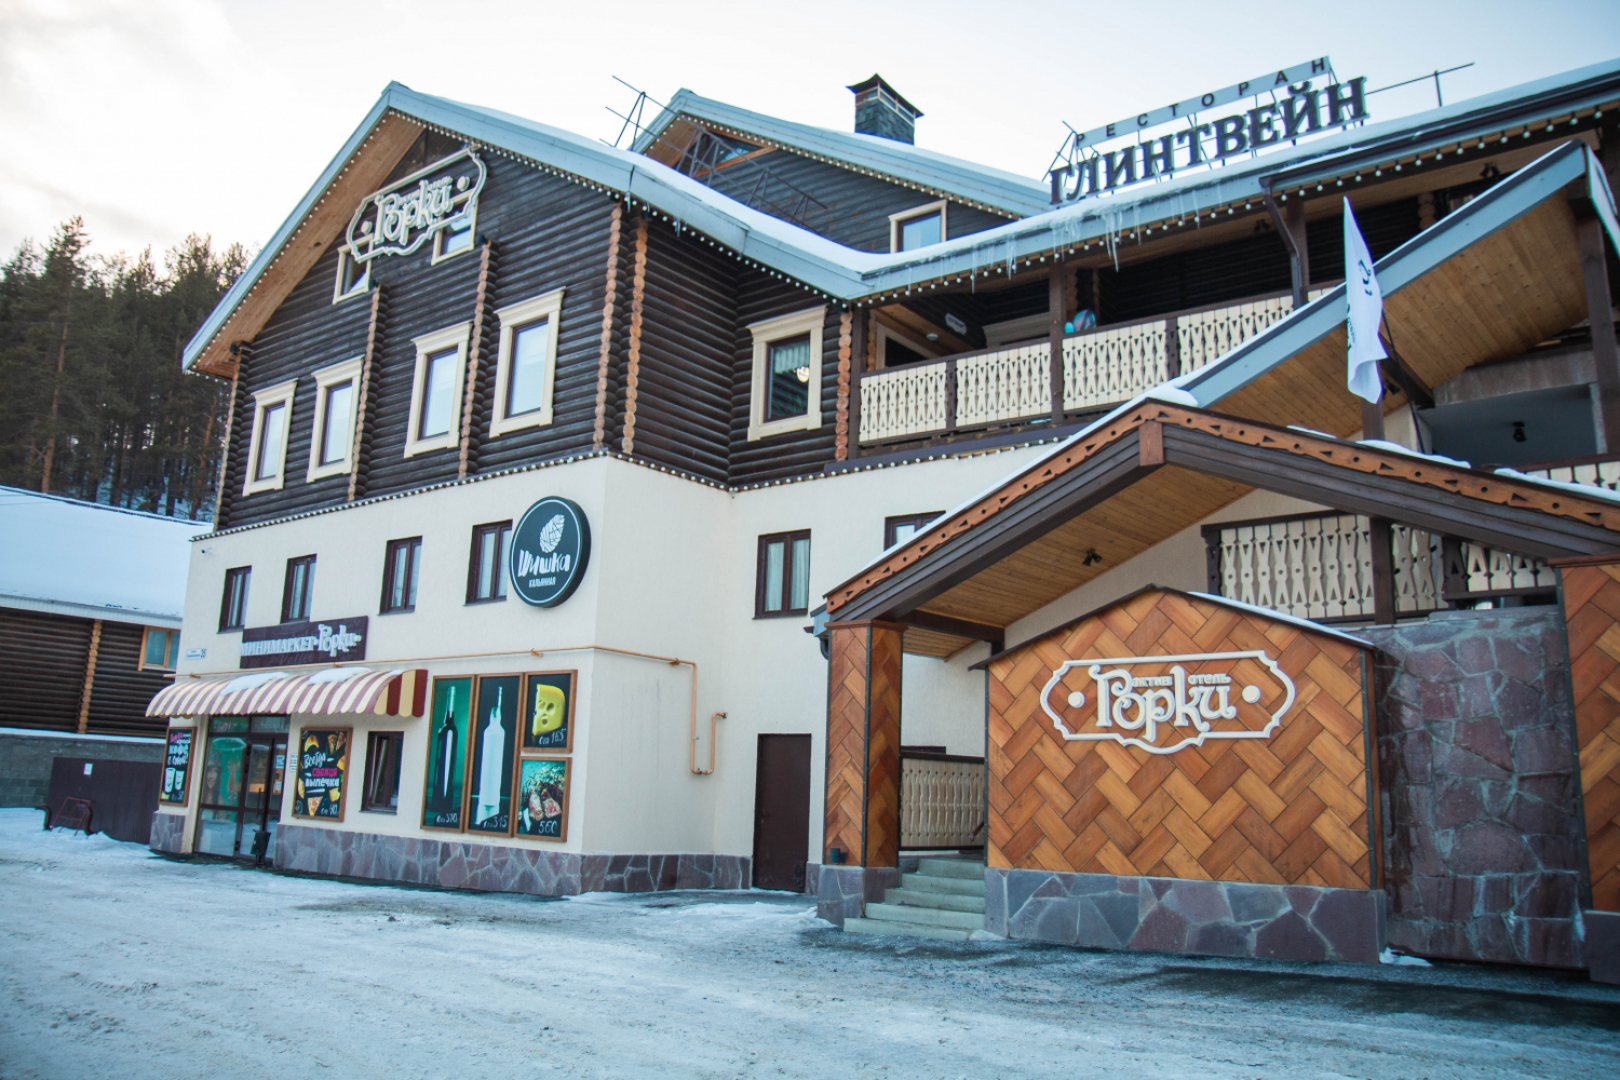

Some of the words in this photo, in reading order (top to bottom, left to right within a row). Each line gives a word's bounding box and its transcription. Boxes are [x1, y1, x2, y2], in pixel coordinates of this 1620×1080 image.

[1075, 57, 1326, 147] РЕСТОРАН
[1049, 76, 1369, 206] ГЛИНТВЕЙН
[374, 178, 454, 246] Горки
[517, 549, 571, 578] Шишка
[528, 577, 556, 588] КАЛЬЯННАЯ
[240, 636, 315, 656] МИНИМАРКЕТ
[317, 623, 357, 657] Горки
[1132, 675, 1173, 688] актив
[1188, 673, 1231, 685] отель
[1088, 664, 1237, 742] Горки
[539, 820, 557, 834] 560
